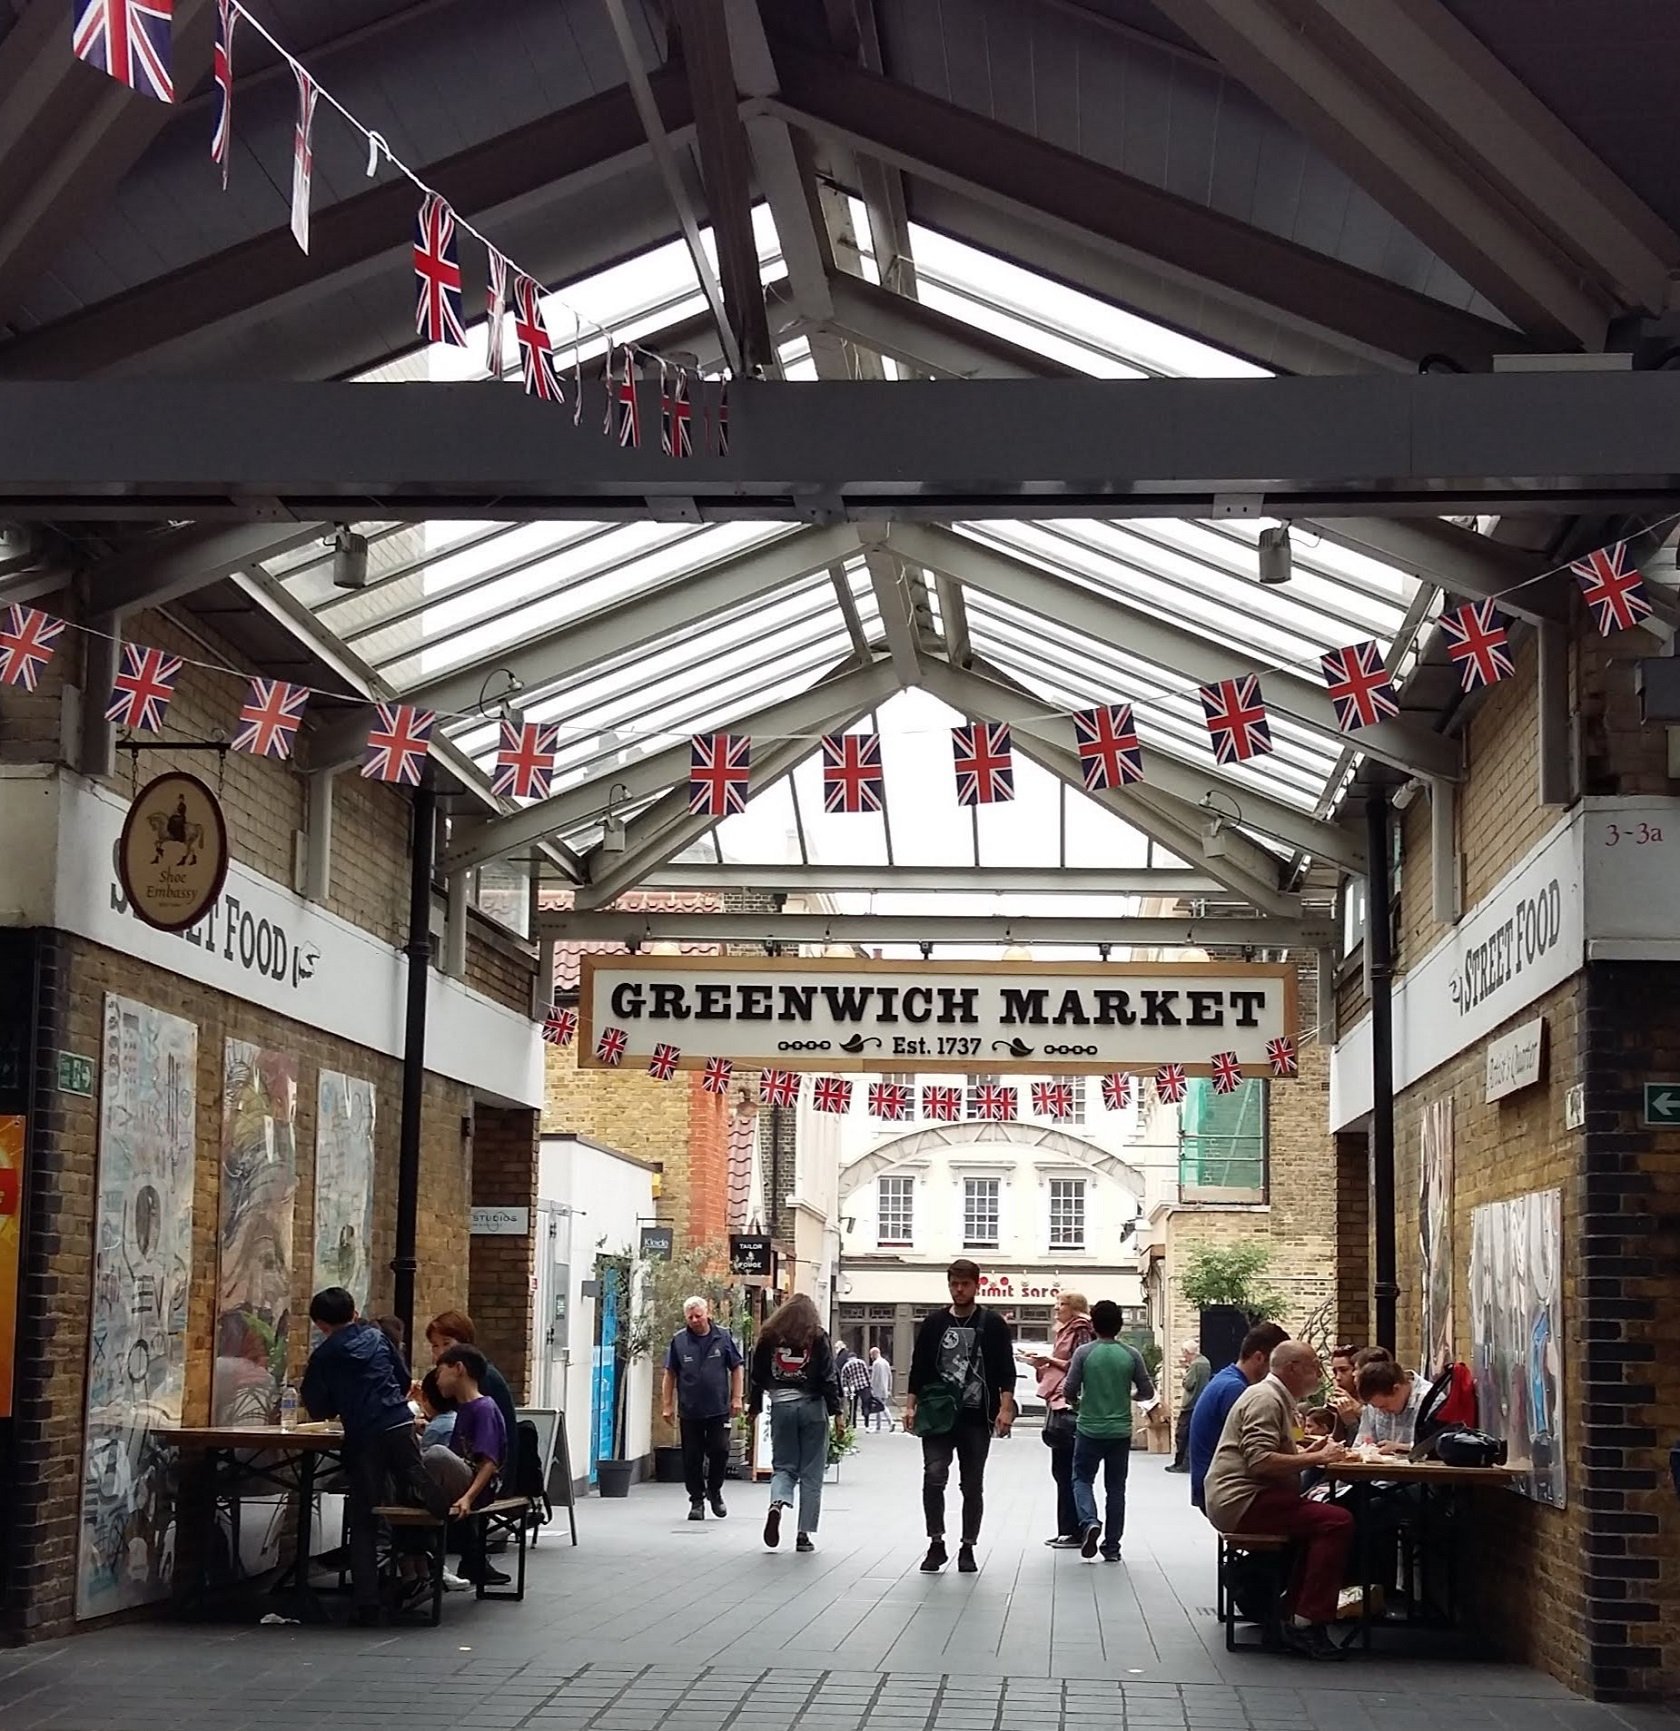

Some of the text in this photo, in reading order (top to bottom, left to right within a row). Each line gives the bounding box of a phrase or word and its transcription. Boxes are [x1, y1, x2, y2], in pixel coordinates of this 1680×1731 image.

[160, 866, 187, 883] Shoe
[147, 884, 198, 905] Embassy
[223, 894, 287, 981] FOOD
[1465, 878, 1560, 1014] STREET FOOD
[611, 982, 1266, 1027] GREENWICH MARKET
[892, 1036, 982, 1055] Est. 1737
[1021, 1288, 1061, 1297] sara
